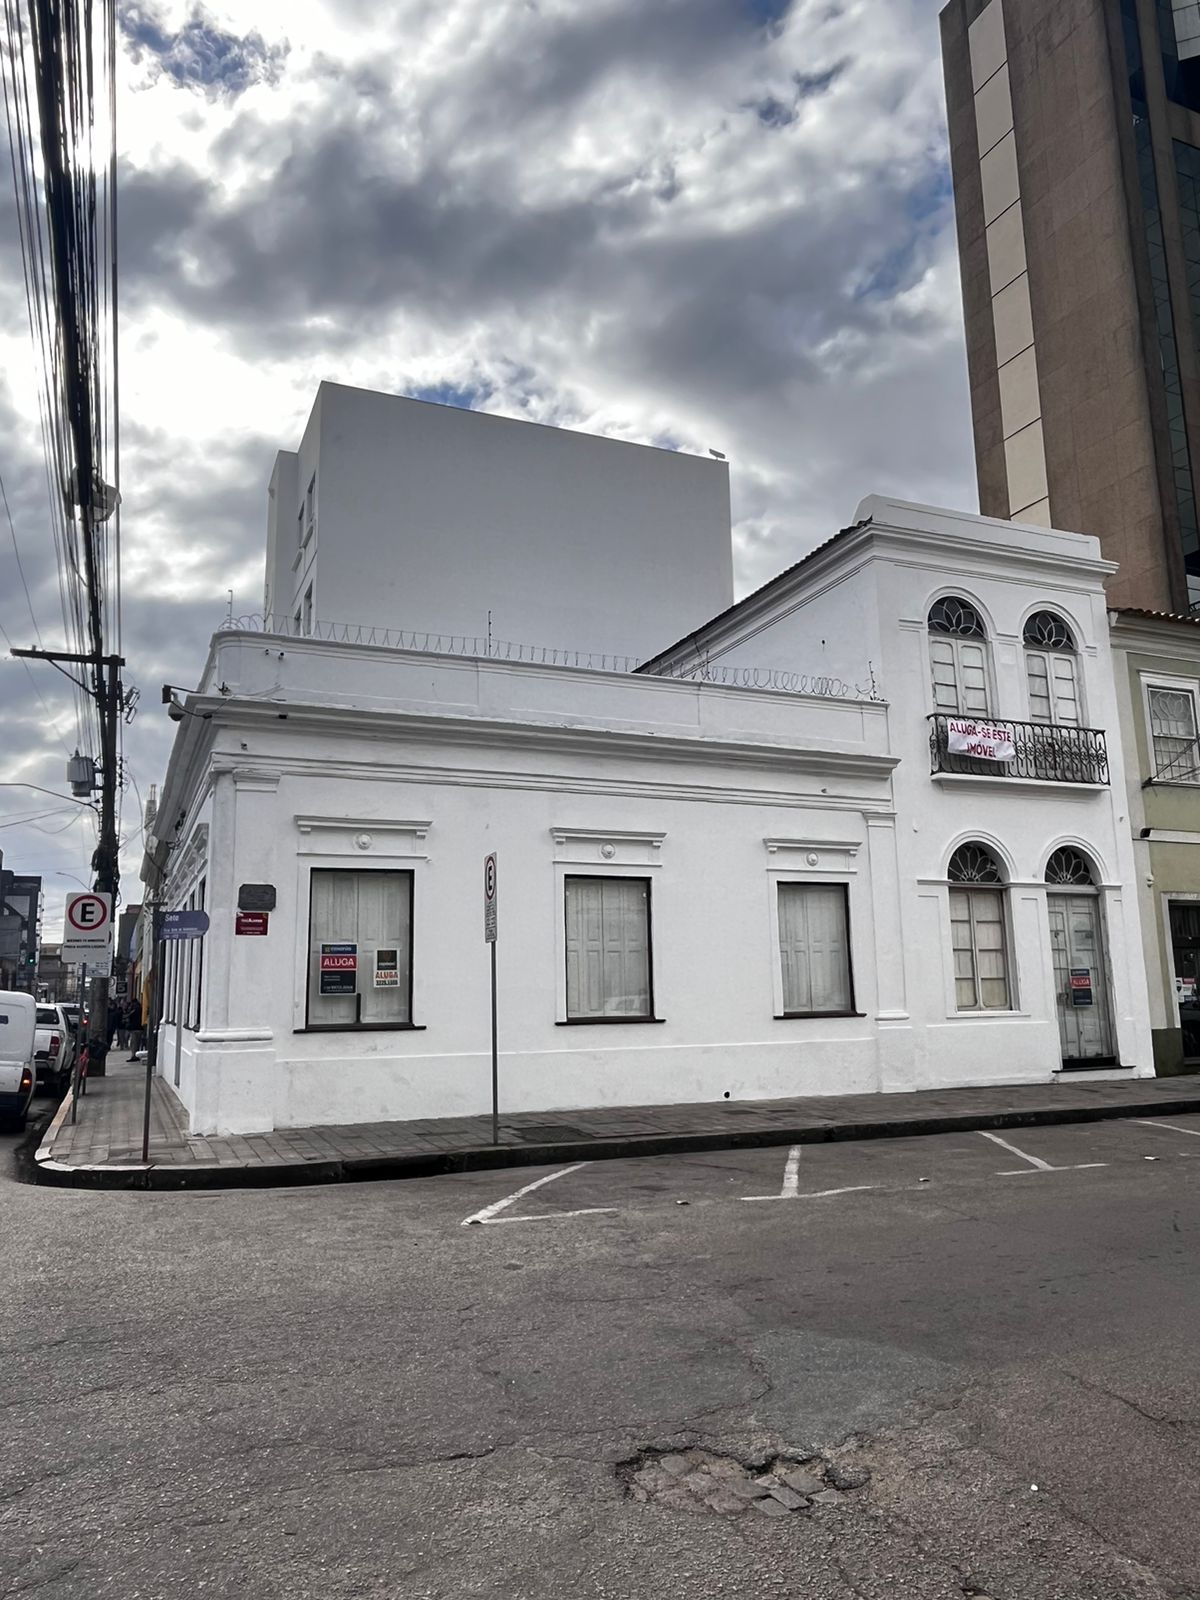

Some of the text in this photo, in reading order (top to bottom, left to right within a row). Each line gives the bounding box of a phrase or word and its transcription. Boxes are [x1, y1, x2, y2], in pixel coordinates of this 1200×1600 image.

[949, 722, 1012, 743] ALUGA-SE ESTE
[966, 740, 996, 758] IMÓVEL
[487, 866, 493, 890] E
[81, 903, 95, 922] E
[323, 958, 355, 967] ALUGA
[375, 971, 399, 979] ALUGA
